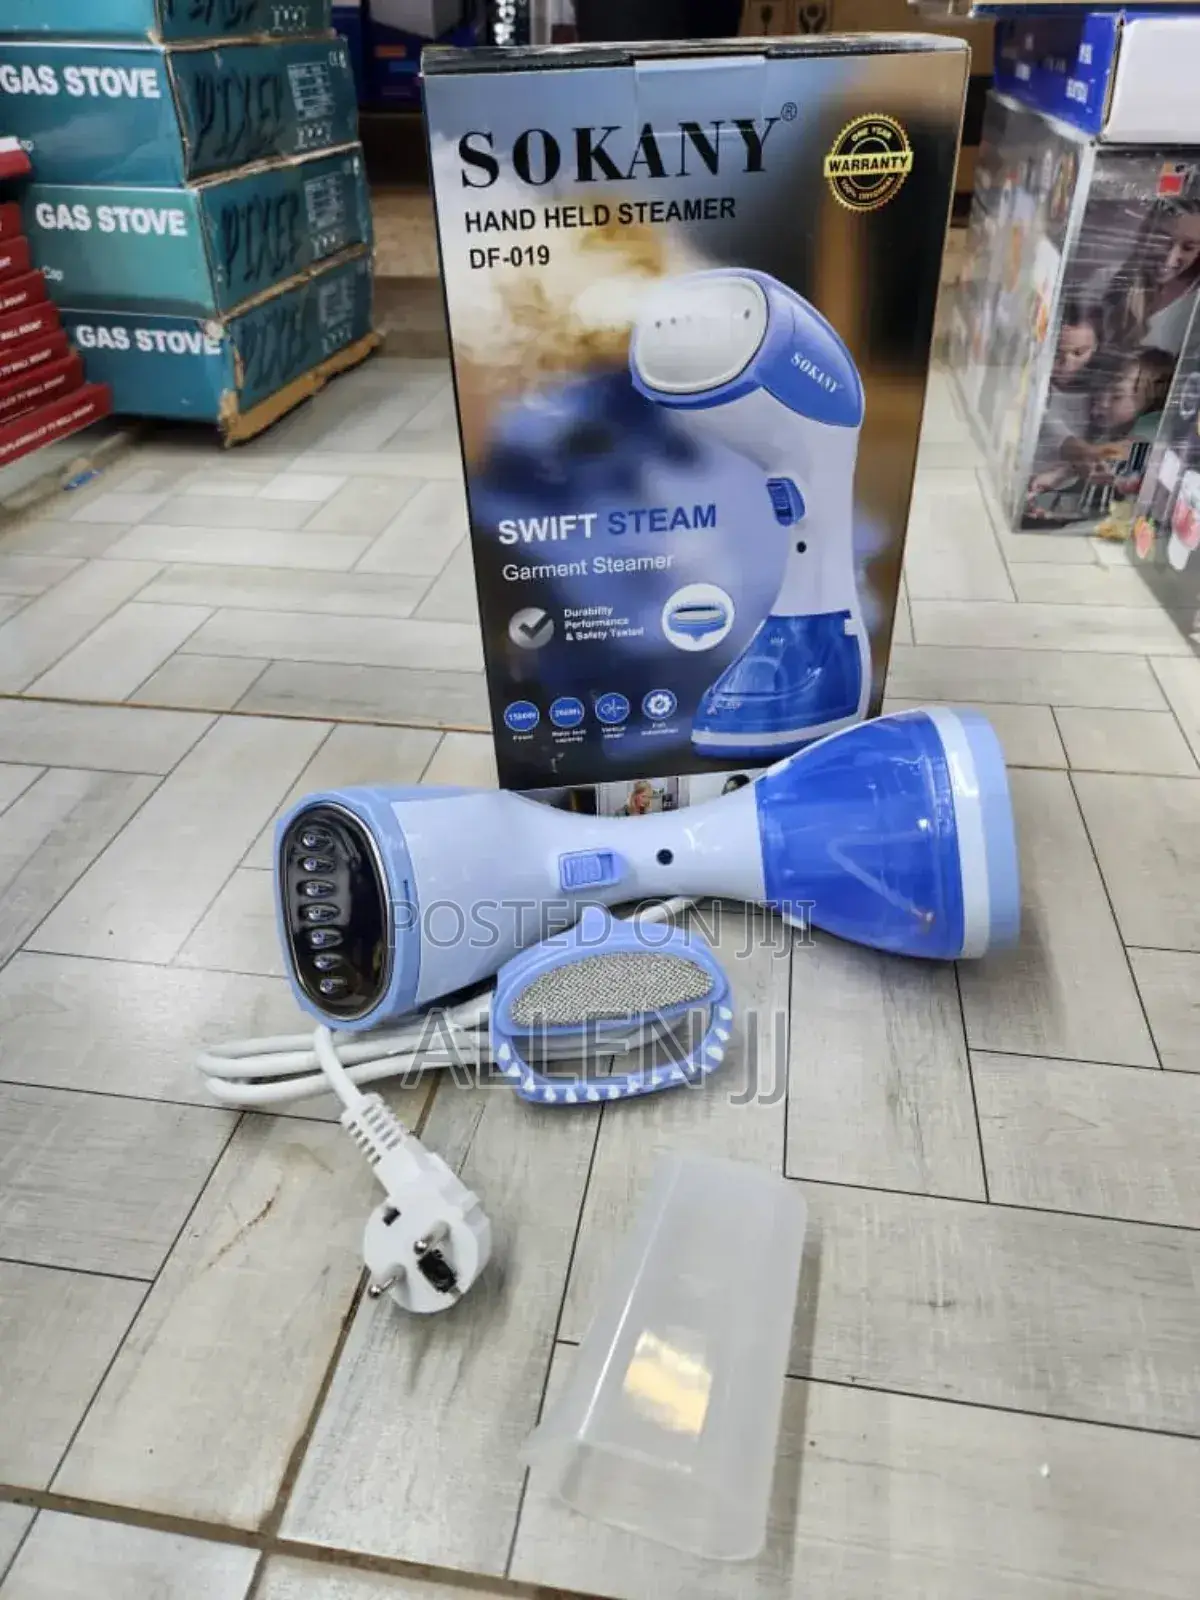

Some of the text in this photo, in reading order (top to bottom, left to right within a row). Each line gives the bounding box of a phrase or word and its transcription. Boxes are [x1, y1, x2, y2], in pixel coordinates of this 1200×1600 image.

[0, 65, 160, 98] GAS STOVE
[828, 155, 908, 173] WARRANTY
[36, 203, 188, 237] GAS STOVE
[465, 197, 736, 233] HAND HELD STEAMER
[469, 244, 551, 270] DF-019
[76, 325, 222, 356] GAS STOVE
[498, 503, 716, 545] SWIFT STEAM
[502, 553, 675, 582] Garment Steamer
[564, 605, 613, 618] Durability
